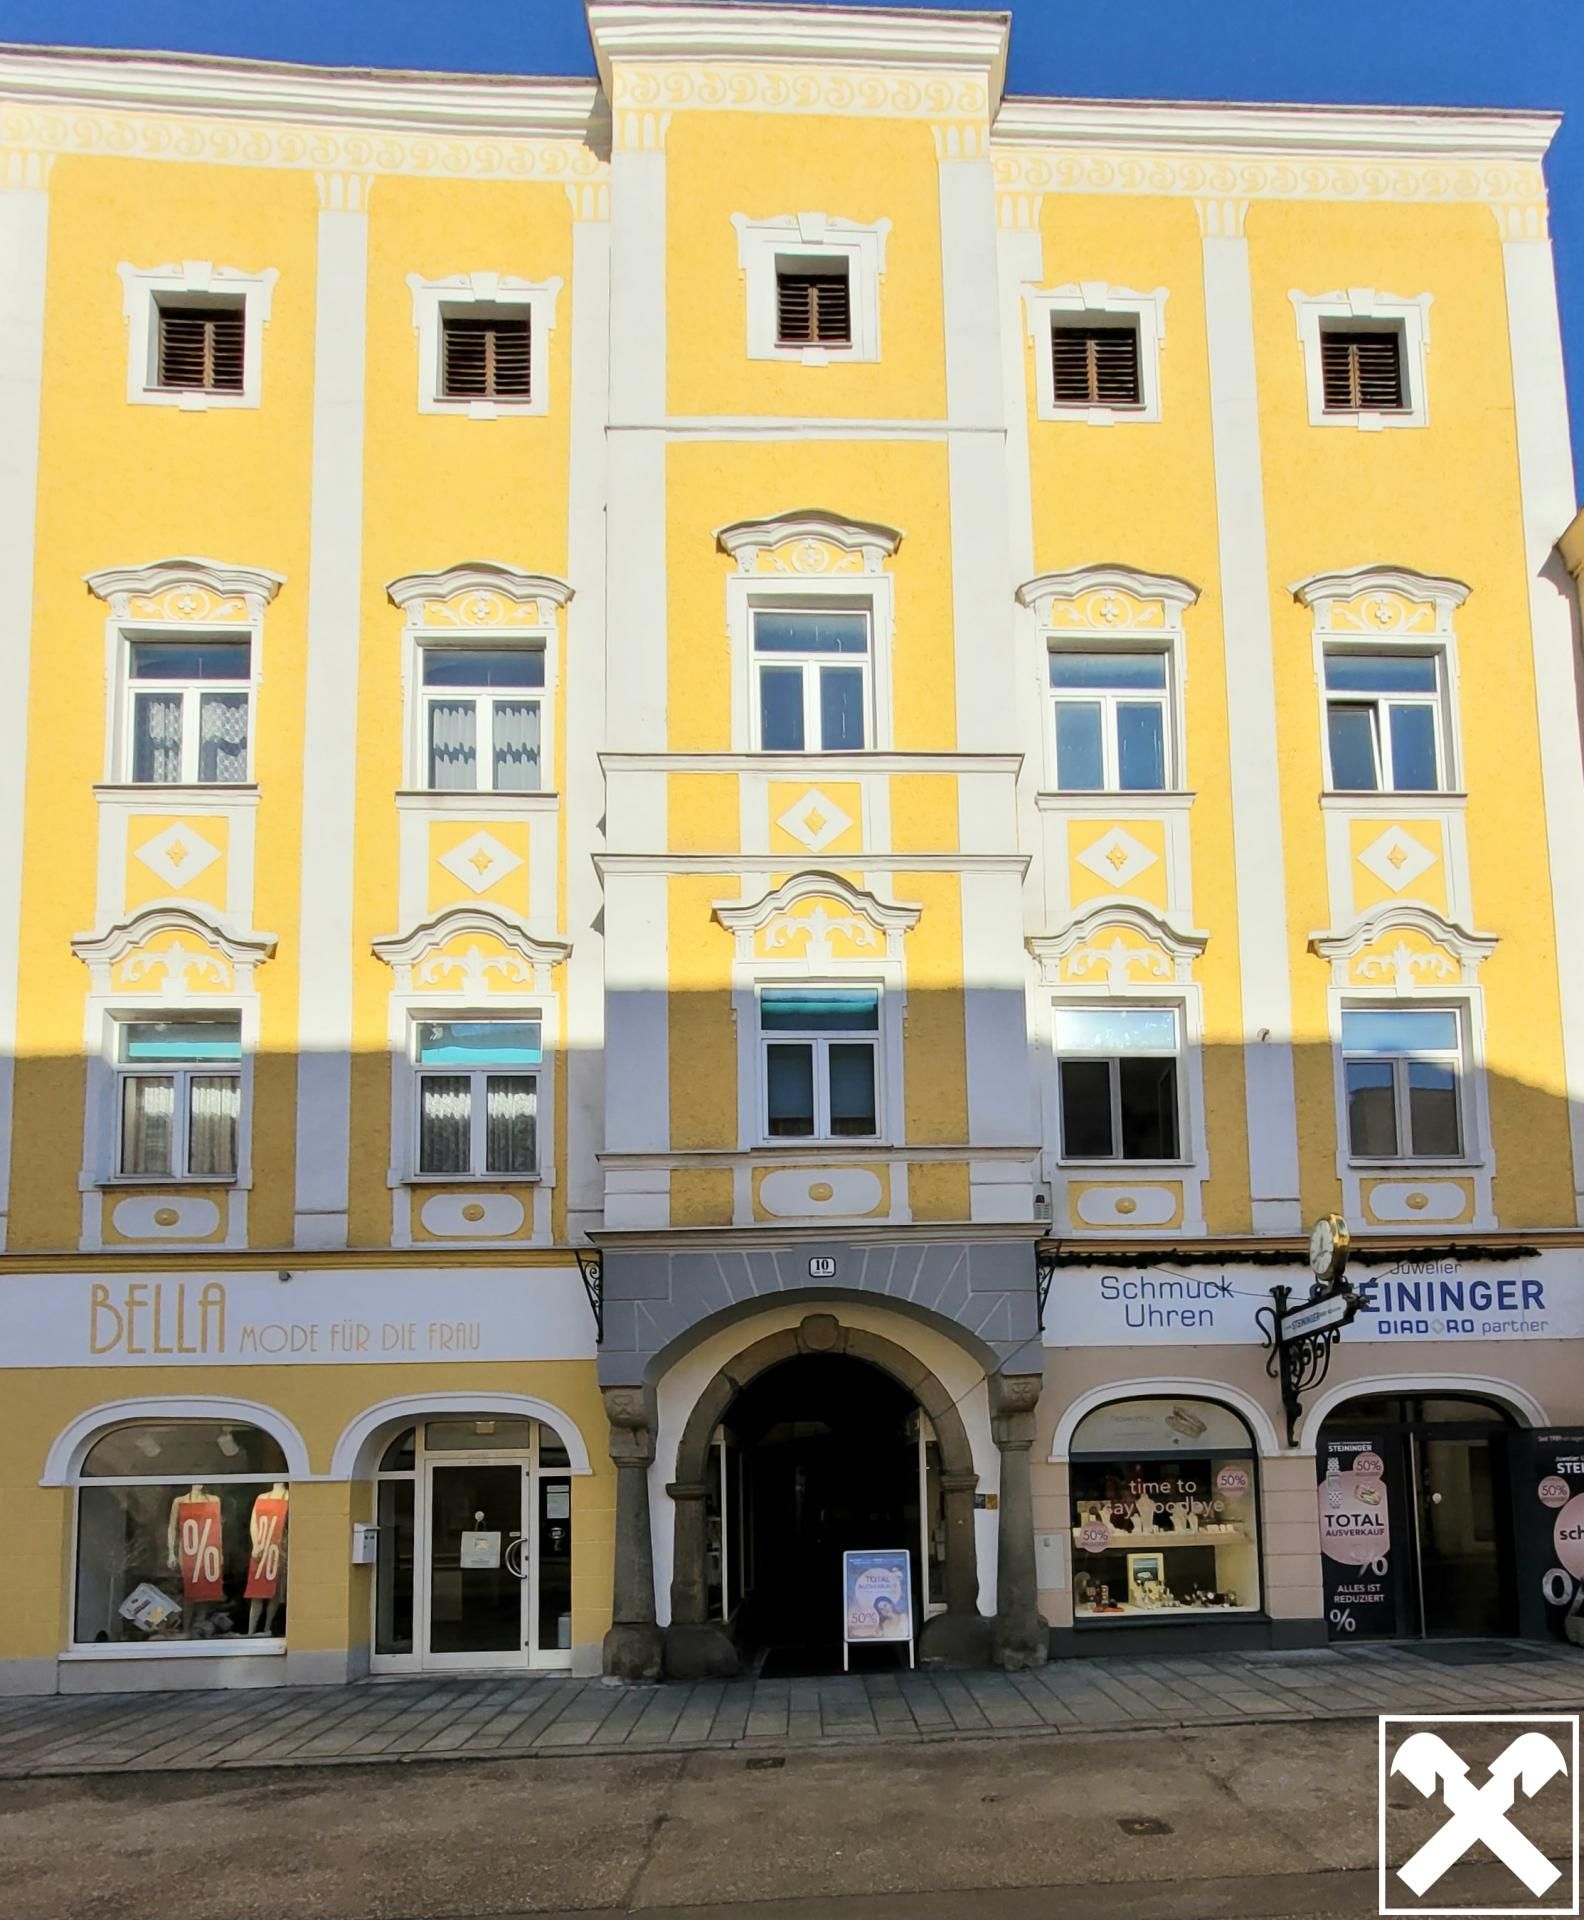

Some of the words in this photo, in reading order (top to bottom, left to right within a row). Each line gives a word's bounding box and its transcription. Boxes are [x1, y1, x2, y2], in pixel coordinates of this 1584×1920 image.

[816, 1259, 829, 1271] 10
[1101, 1275, 1235, 1300] Schmuck
[1309, 1280, 1546, 1313] EININGER
[90, 1282, 226, 1354] BELLA
[239, 1324, 319, 1353] MODE
[330, 1319, 369, 1352] FÜR
[381, 1323, 417, 1351] DIE
[428, 1321, 481, 1351] FRAU
[1125, 1303, 1214, 1328] Uhren
[1481, 1320, 1549, 1336] partner
[1356, 1460, 1381, 1472] 50%
[1128, 1478, 1171, 1495] time
[1177, 1479, 1197, 1494] to
[1220, 1475, 1246, 1487] 50%
[1541, 1484, 1567, 1497] 50%
[1324, 1513, 1385, 1528] TOTAL
[1083, 1529, 1109, 1541] 50%
[1325, 1528, 1385, 1537] AUSVERKAUF
[1337, 1584, 1366, 1593] ALLES
[1367, 1583, 1382, 1592] IST
[1333, 1594, 1385, 1604] REDUZIERT
[1329, 1608, 1357, 1632] %
